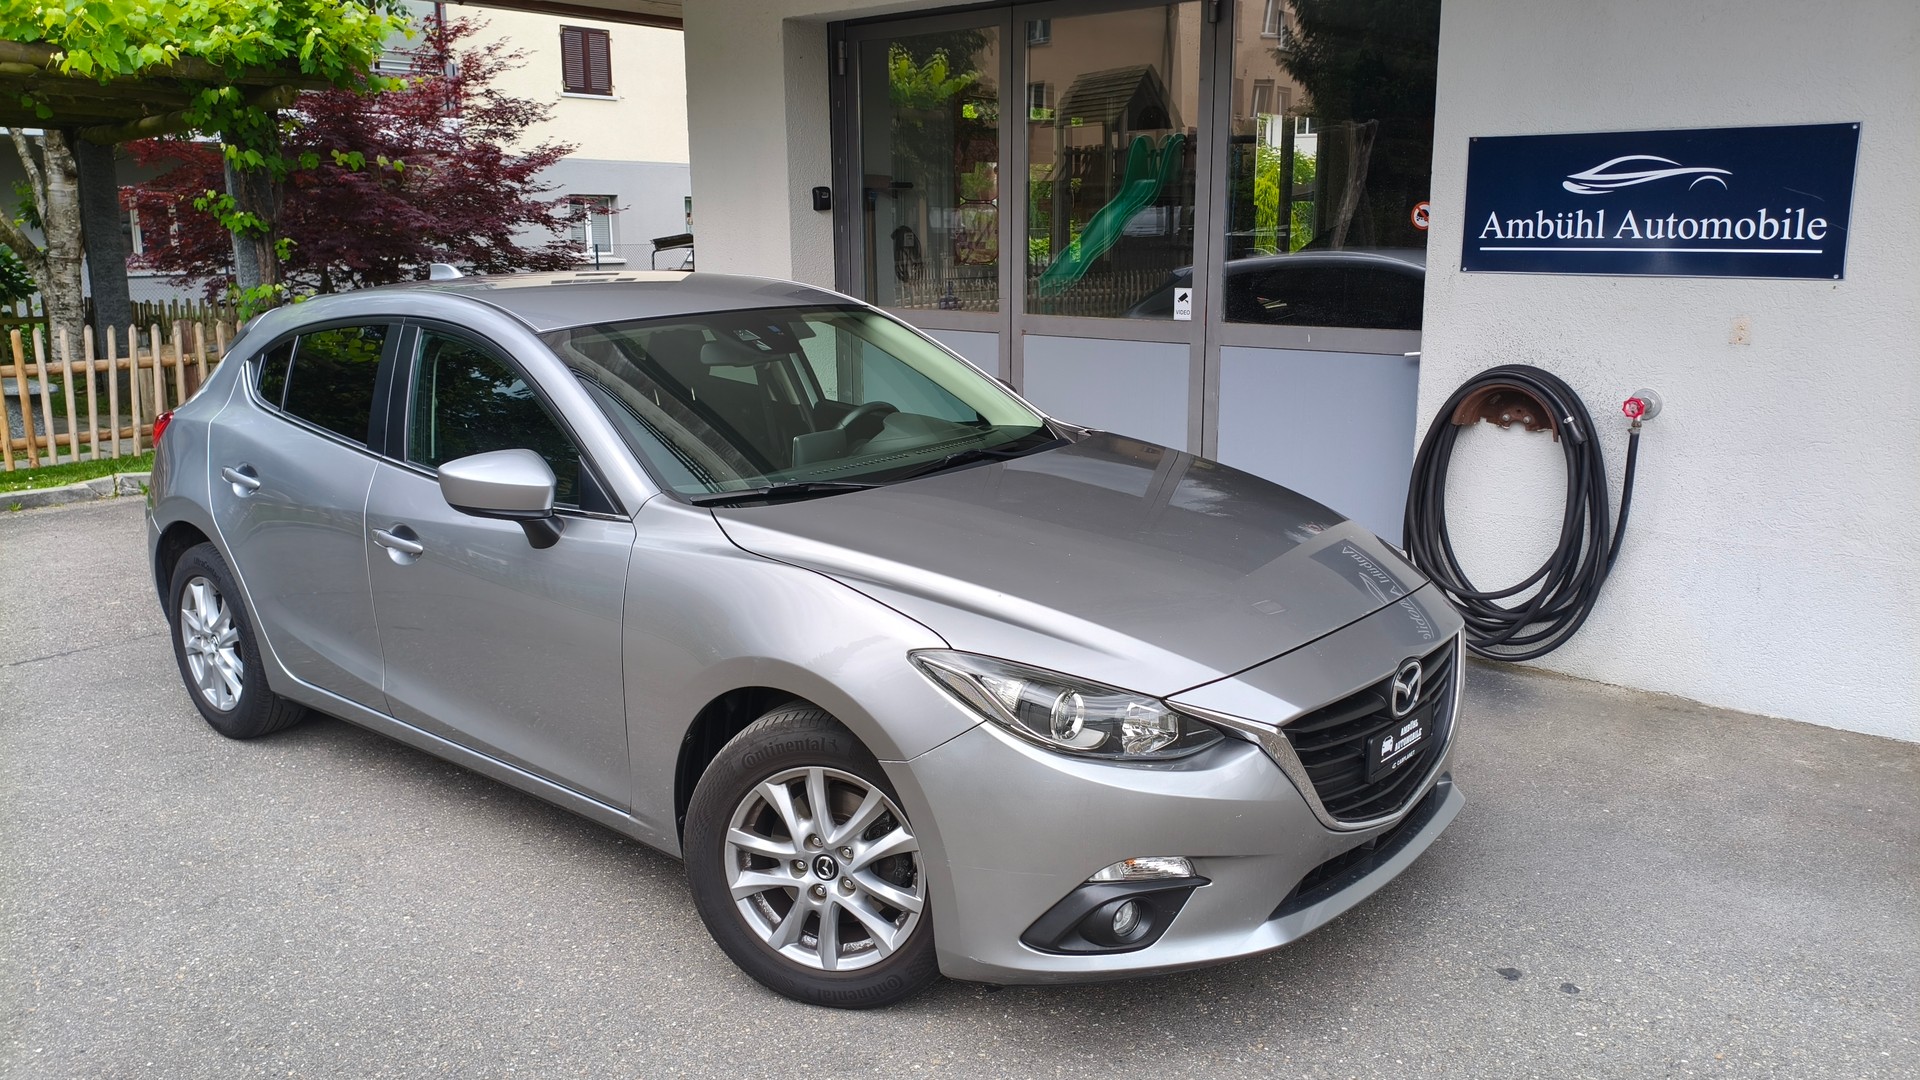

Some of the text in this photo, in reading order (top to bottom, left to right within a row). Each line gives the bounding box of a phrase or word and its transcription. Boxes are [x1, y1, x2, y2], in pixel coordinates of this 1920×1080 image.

[1478, 207, 1828, 241] Ambühl Automobile
[741, 737, 826, 770] Continental
[815, 974, 904, 1001] Continental
